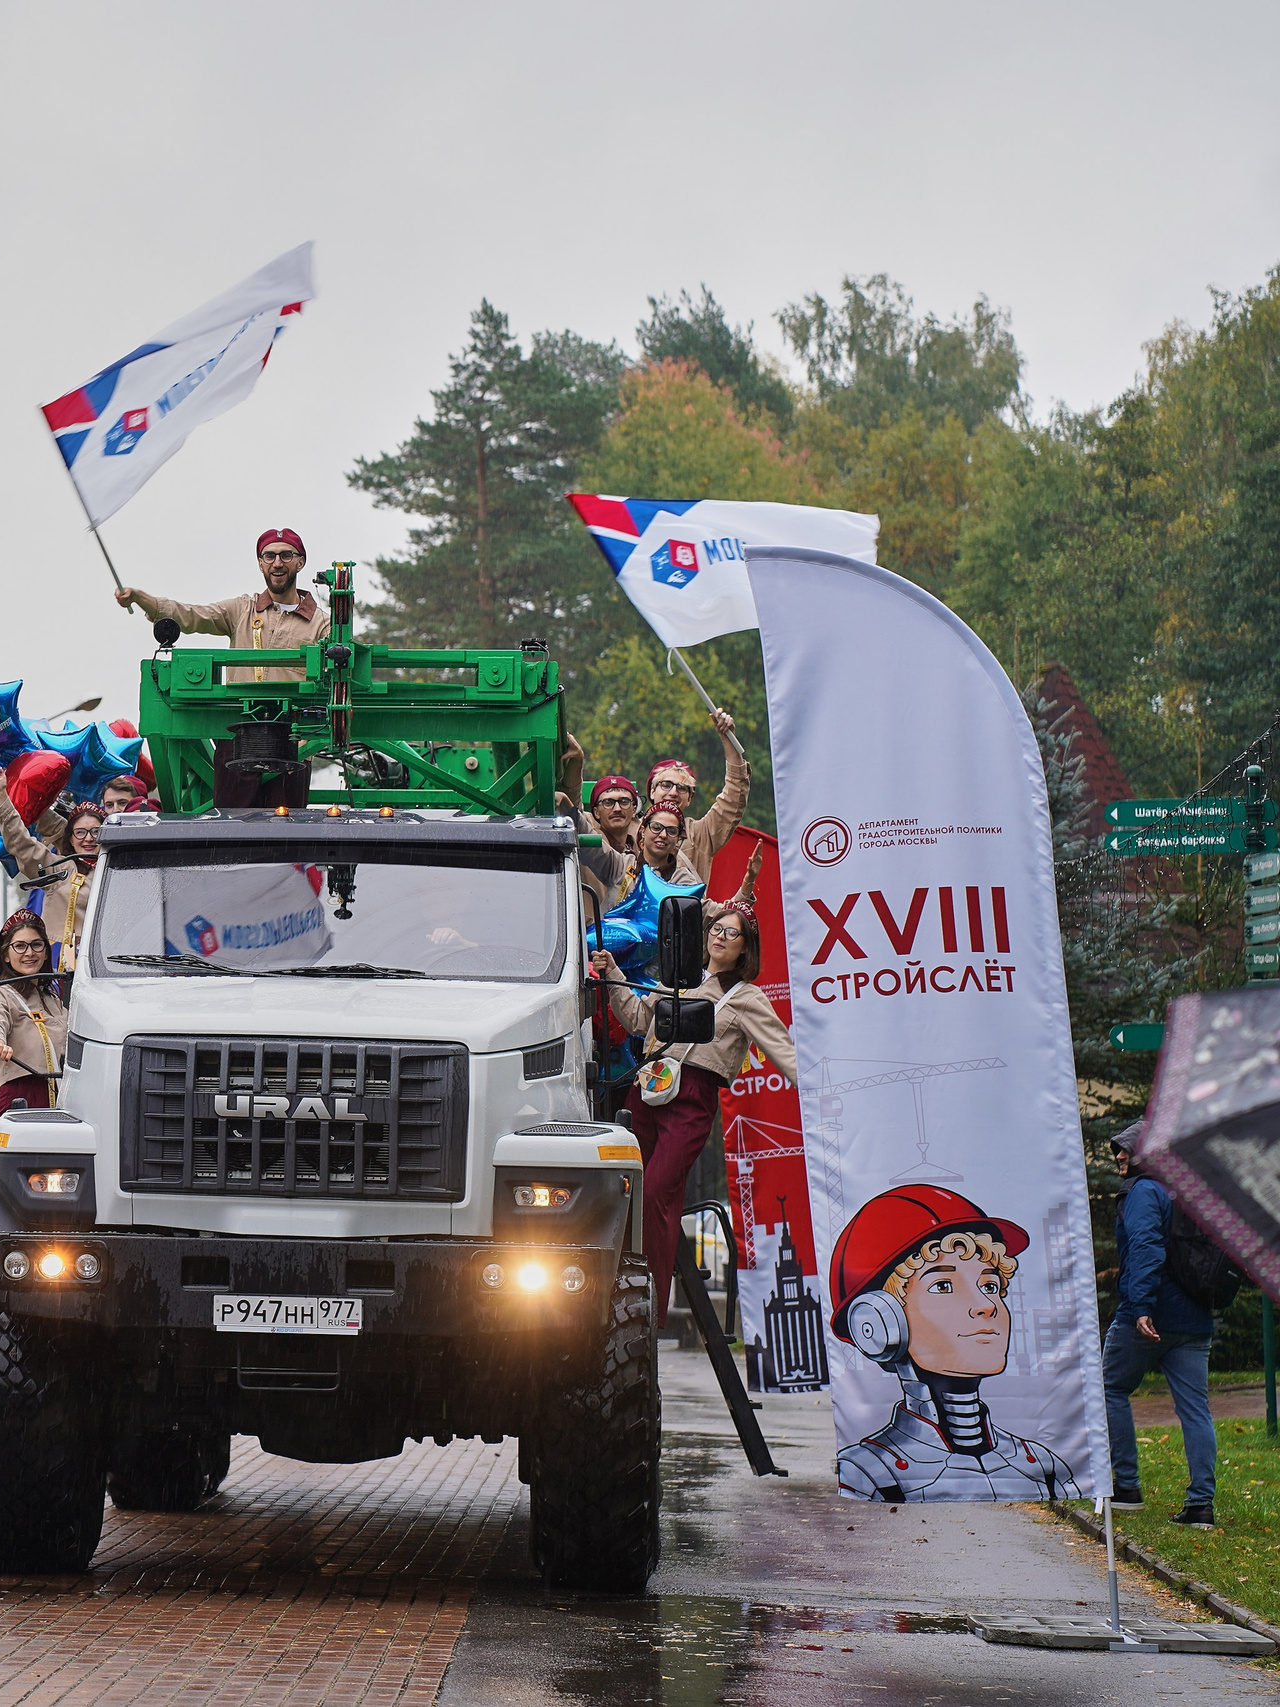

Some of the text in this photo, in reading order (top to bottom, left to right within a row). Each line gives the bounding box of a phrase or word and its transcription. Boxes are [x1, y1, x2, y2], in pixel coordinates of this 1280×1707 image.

[1135, 807, 1168, 819] Шатёр
[857, 818, 919, 831] ДЕПАРТАМЕНТ
[858, 825, 1003, 840] ГРАДОСТРОИТЕЛЬНОЙ ПОЛИТИКИ
[859, 837, 938, 849] ГОРОДА МОСКВЫ
[806, 886, 1011, 966] XVIII
[810, 959, 1016, 1004] СТРОЙСЛЁТ
[214, 1094, 369, 1121] URAL
[319, 1300, 355, 1318] 977
[328, 1319, 346, 1327] RUS
